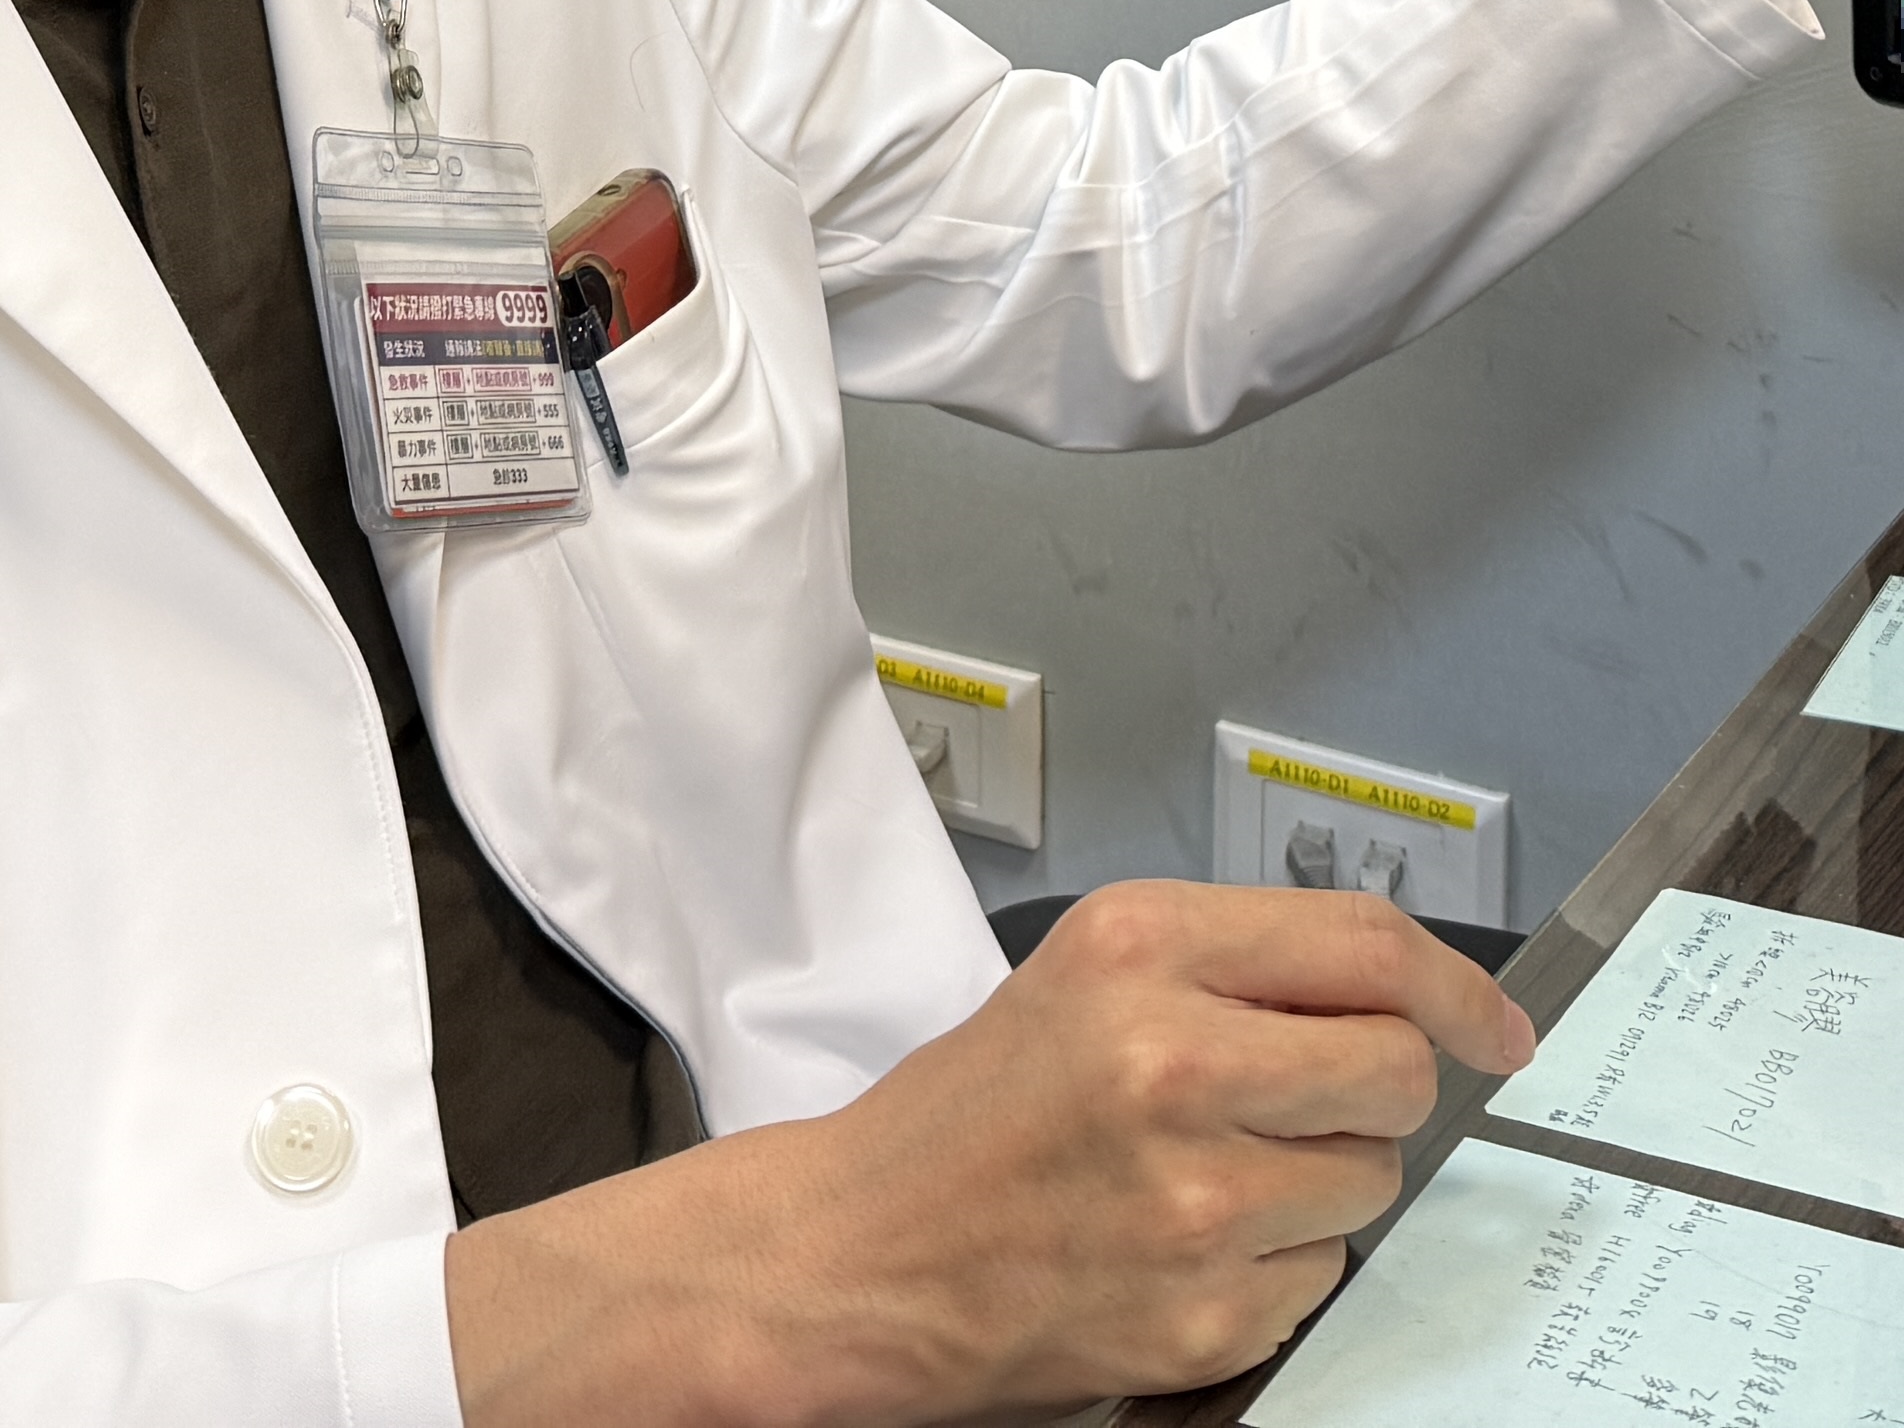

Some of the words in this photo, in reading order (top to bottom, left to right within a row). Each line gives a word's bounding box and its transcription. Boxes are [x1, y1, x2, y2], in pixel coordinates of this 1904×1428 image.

[369, 295, 496, 322] 以下狀況請撥打緊急專線
[500, 292, 549, 325] 9999
[388, 373, 429, 392] 急救事件
[393, 406, 433, 425] 火災事件
[401, 472, 441, 493] 大量傷患
